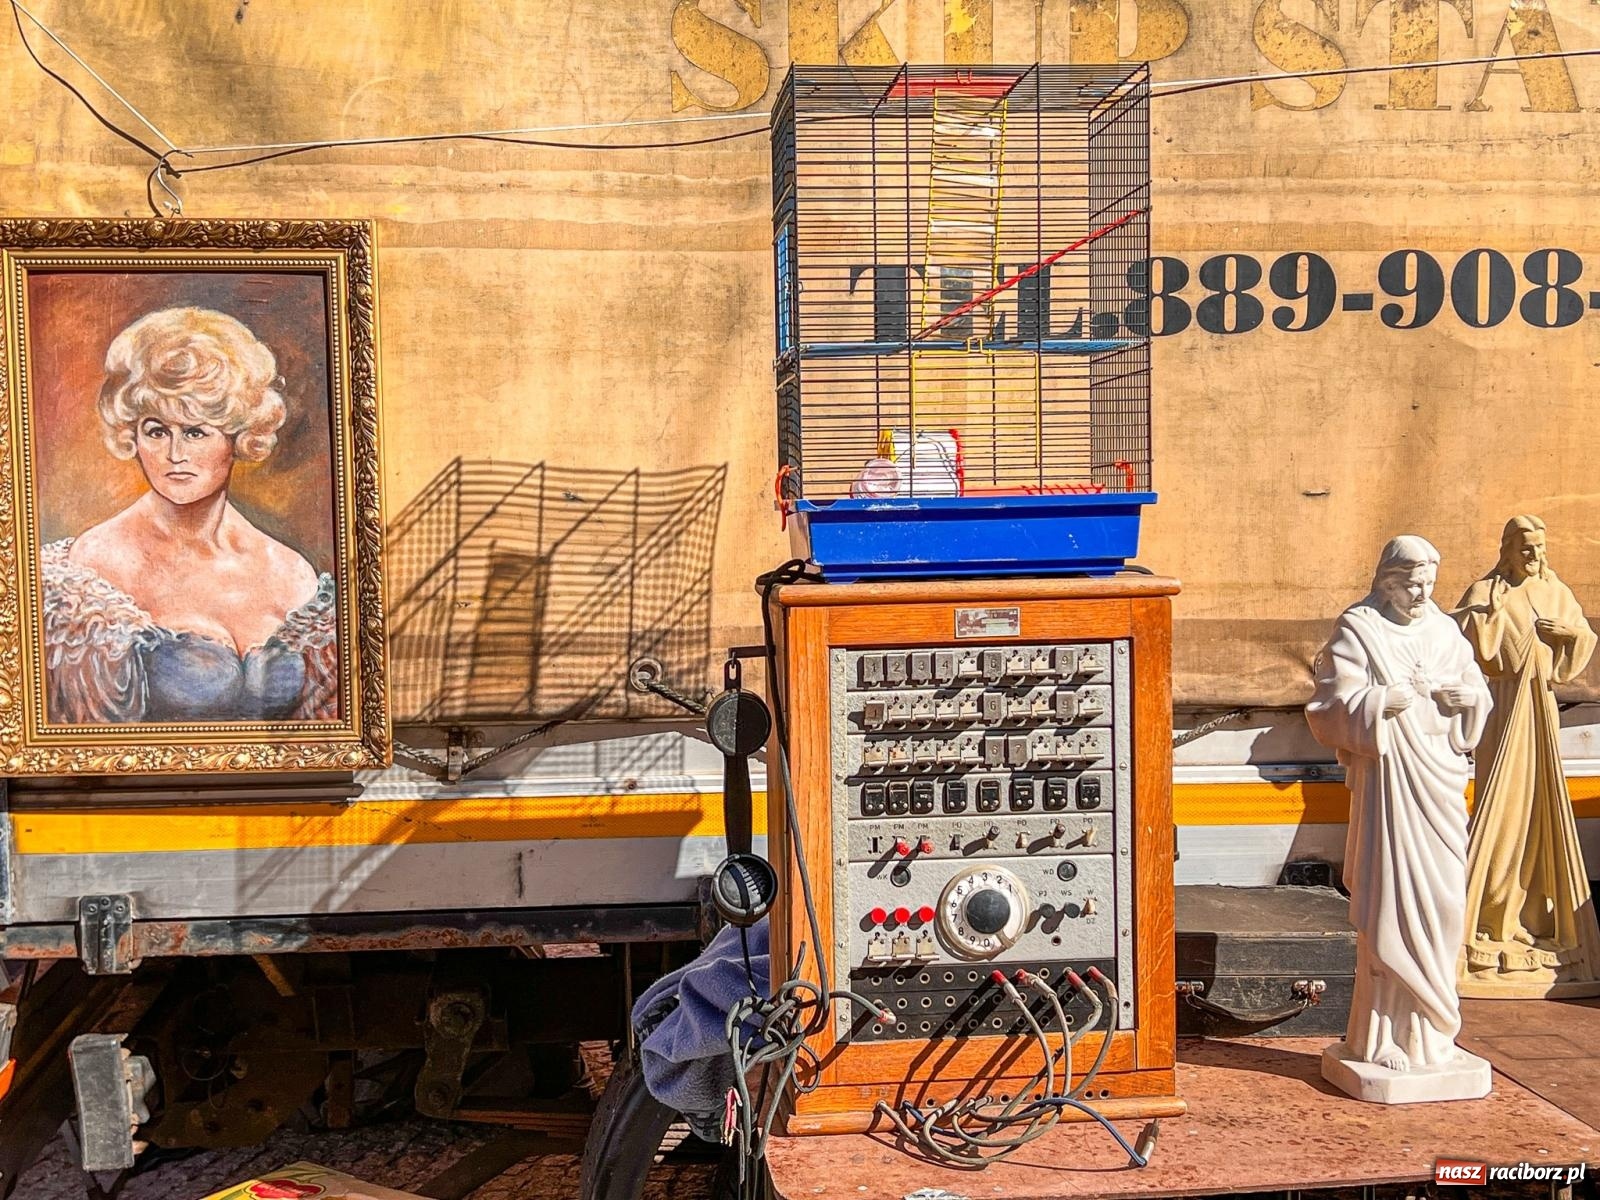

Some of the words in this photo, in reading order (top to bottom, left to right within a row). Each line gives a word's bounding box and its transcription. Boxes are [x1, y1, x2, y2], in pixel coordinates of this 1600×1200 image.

[1251, 0, 1600, 113] STA
[893, 662, 900, 673] 2
[918, 661, 925, 671] 3
[942, 660, 949, 670] 4
[990, 701, 997, 711] 6
[1015, 744, 1022, 754] 7
[968, 876, 974, 884] 4
[982, 872, 988, 881] 3
[996, 875, 1003, 884] 2
[956, 886, 963, 895] 5
[1008, 884, 1012, 893] 1
[951, 913, 958, 923] 7
[958, 926, 964, 936] 8
[969, 936, 976, 944] 9
[983, 938, 990, 947] 0
